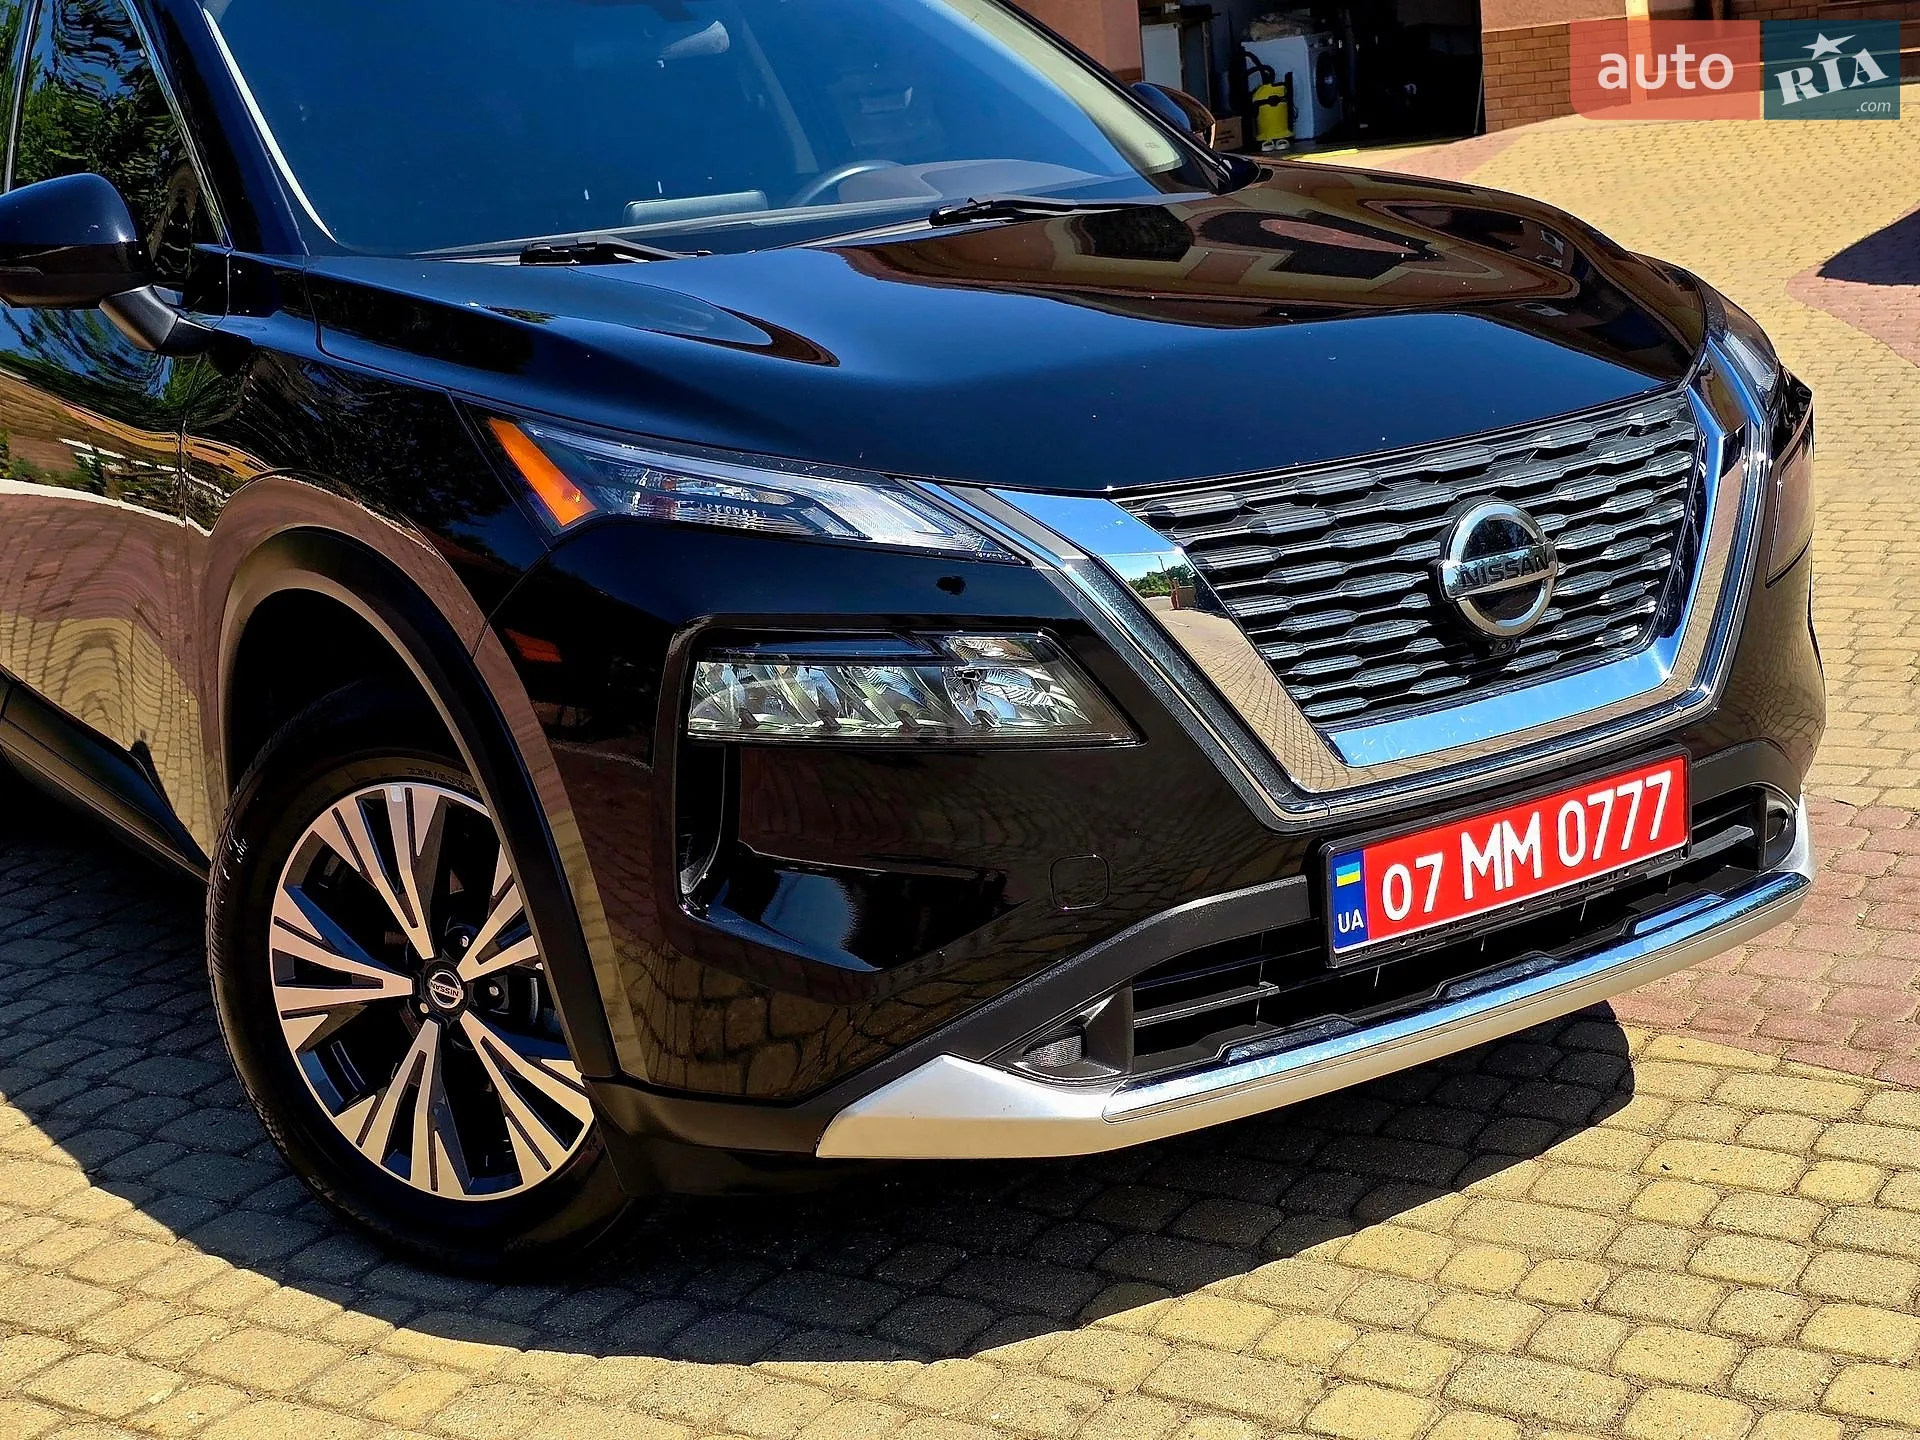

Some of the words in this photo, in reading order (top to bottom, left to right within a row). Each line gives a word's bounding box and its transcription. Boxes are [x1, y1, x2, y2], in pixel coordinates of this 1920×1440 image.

[1458, 547, 1549, 588] NISSAN
[1381, 852, 1444, 921] 07
[1460, 811, 1543, 900] MM
[1556, 770, 1672, 867] 0777
[1338, 911, 1364, 933] UA
[430, 981, 459, 997] NISSAN
